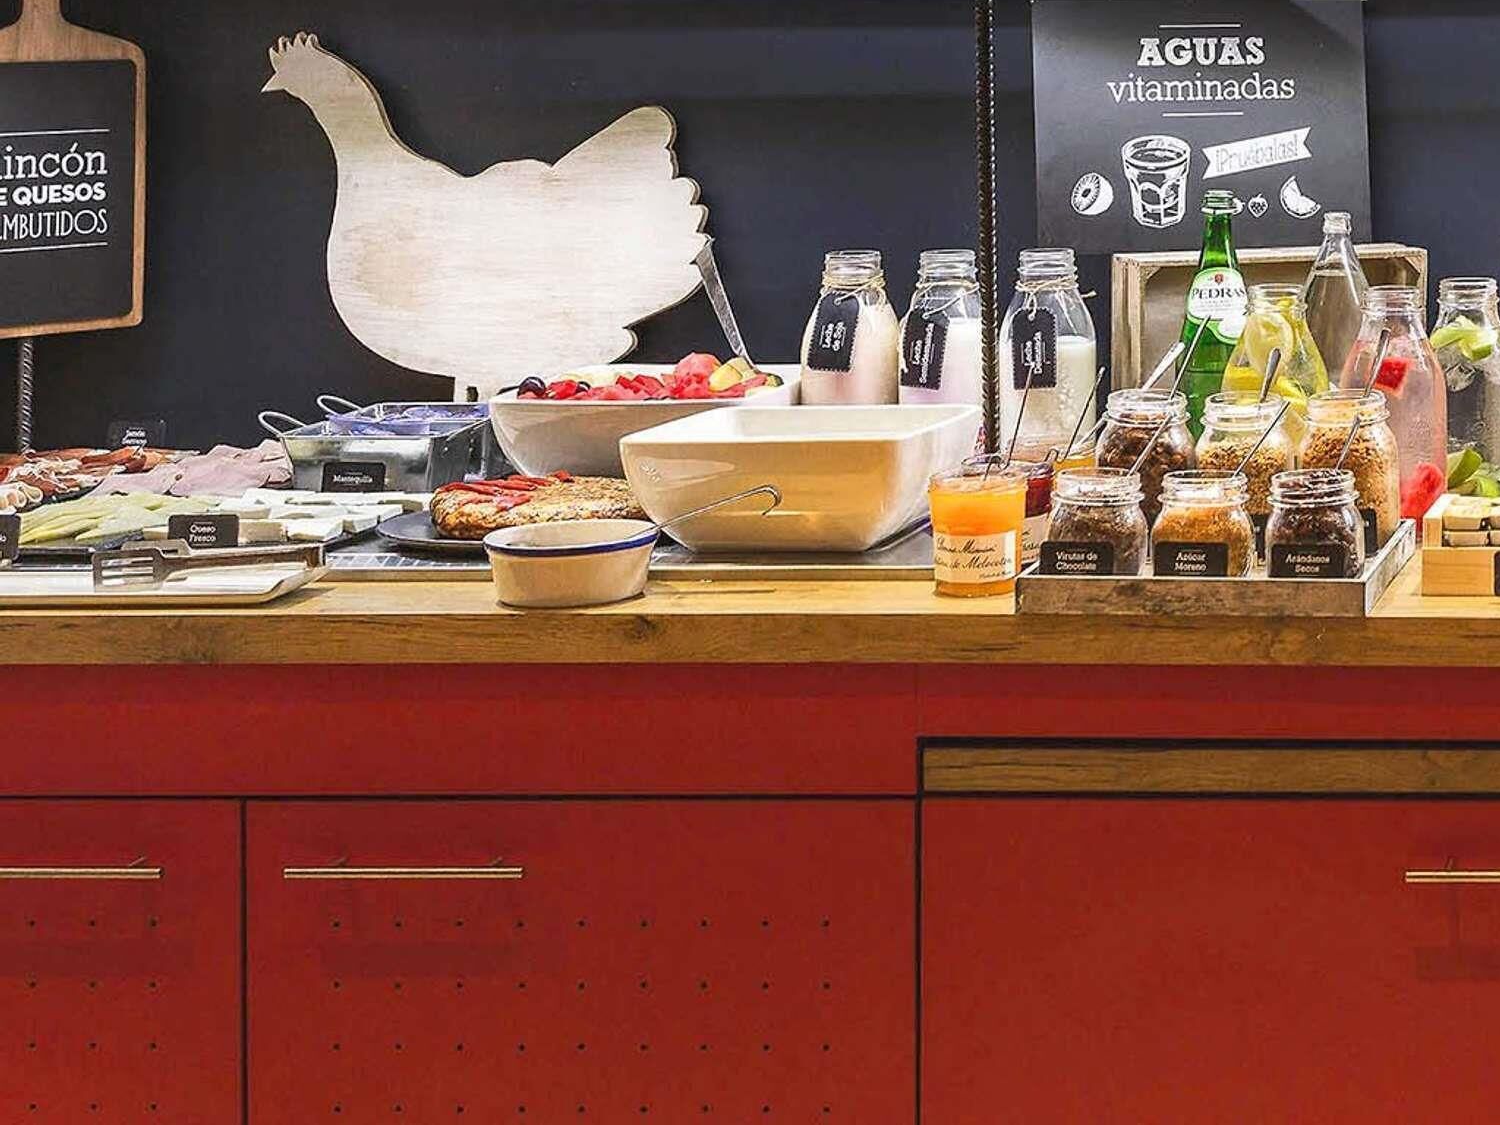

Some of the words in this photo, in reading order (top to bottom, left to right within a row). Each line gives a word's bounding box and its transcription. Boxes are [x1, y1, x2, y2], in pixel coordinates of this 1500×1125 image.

[1137, 36, 1266, 66] AGUAS
[1107, 72, 1296, 104] vitaminadas
[0, 141, 108, 180] incón
[12, 181, 107, 207] QUESOS
[0, 208, 108, 241] MBUTIDOS
[821, 323, 834, 349] Leche
[912, 340, 922, 365] Leche
[1024, 341, 1033, 366] Leche
[1174, 562, 1207, 571] Moreno
